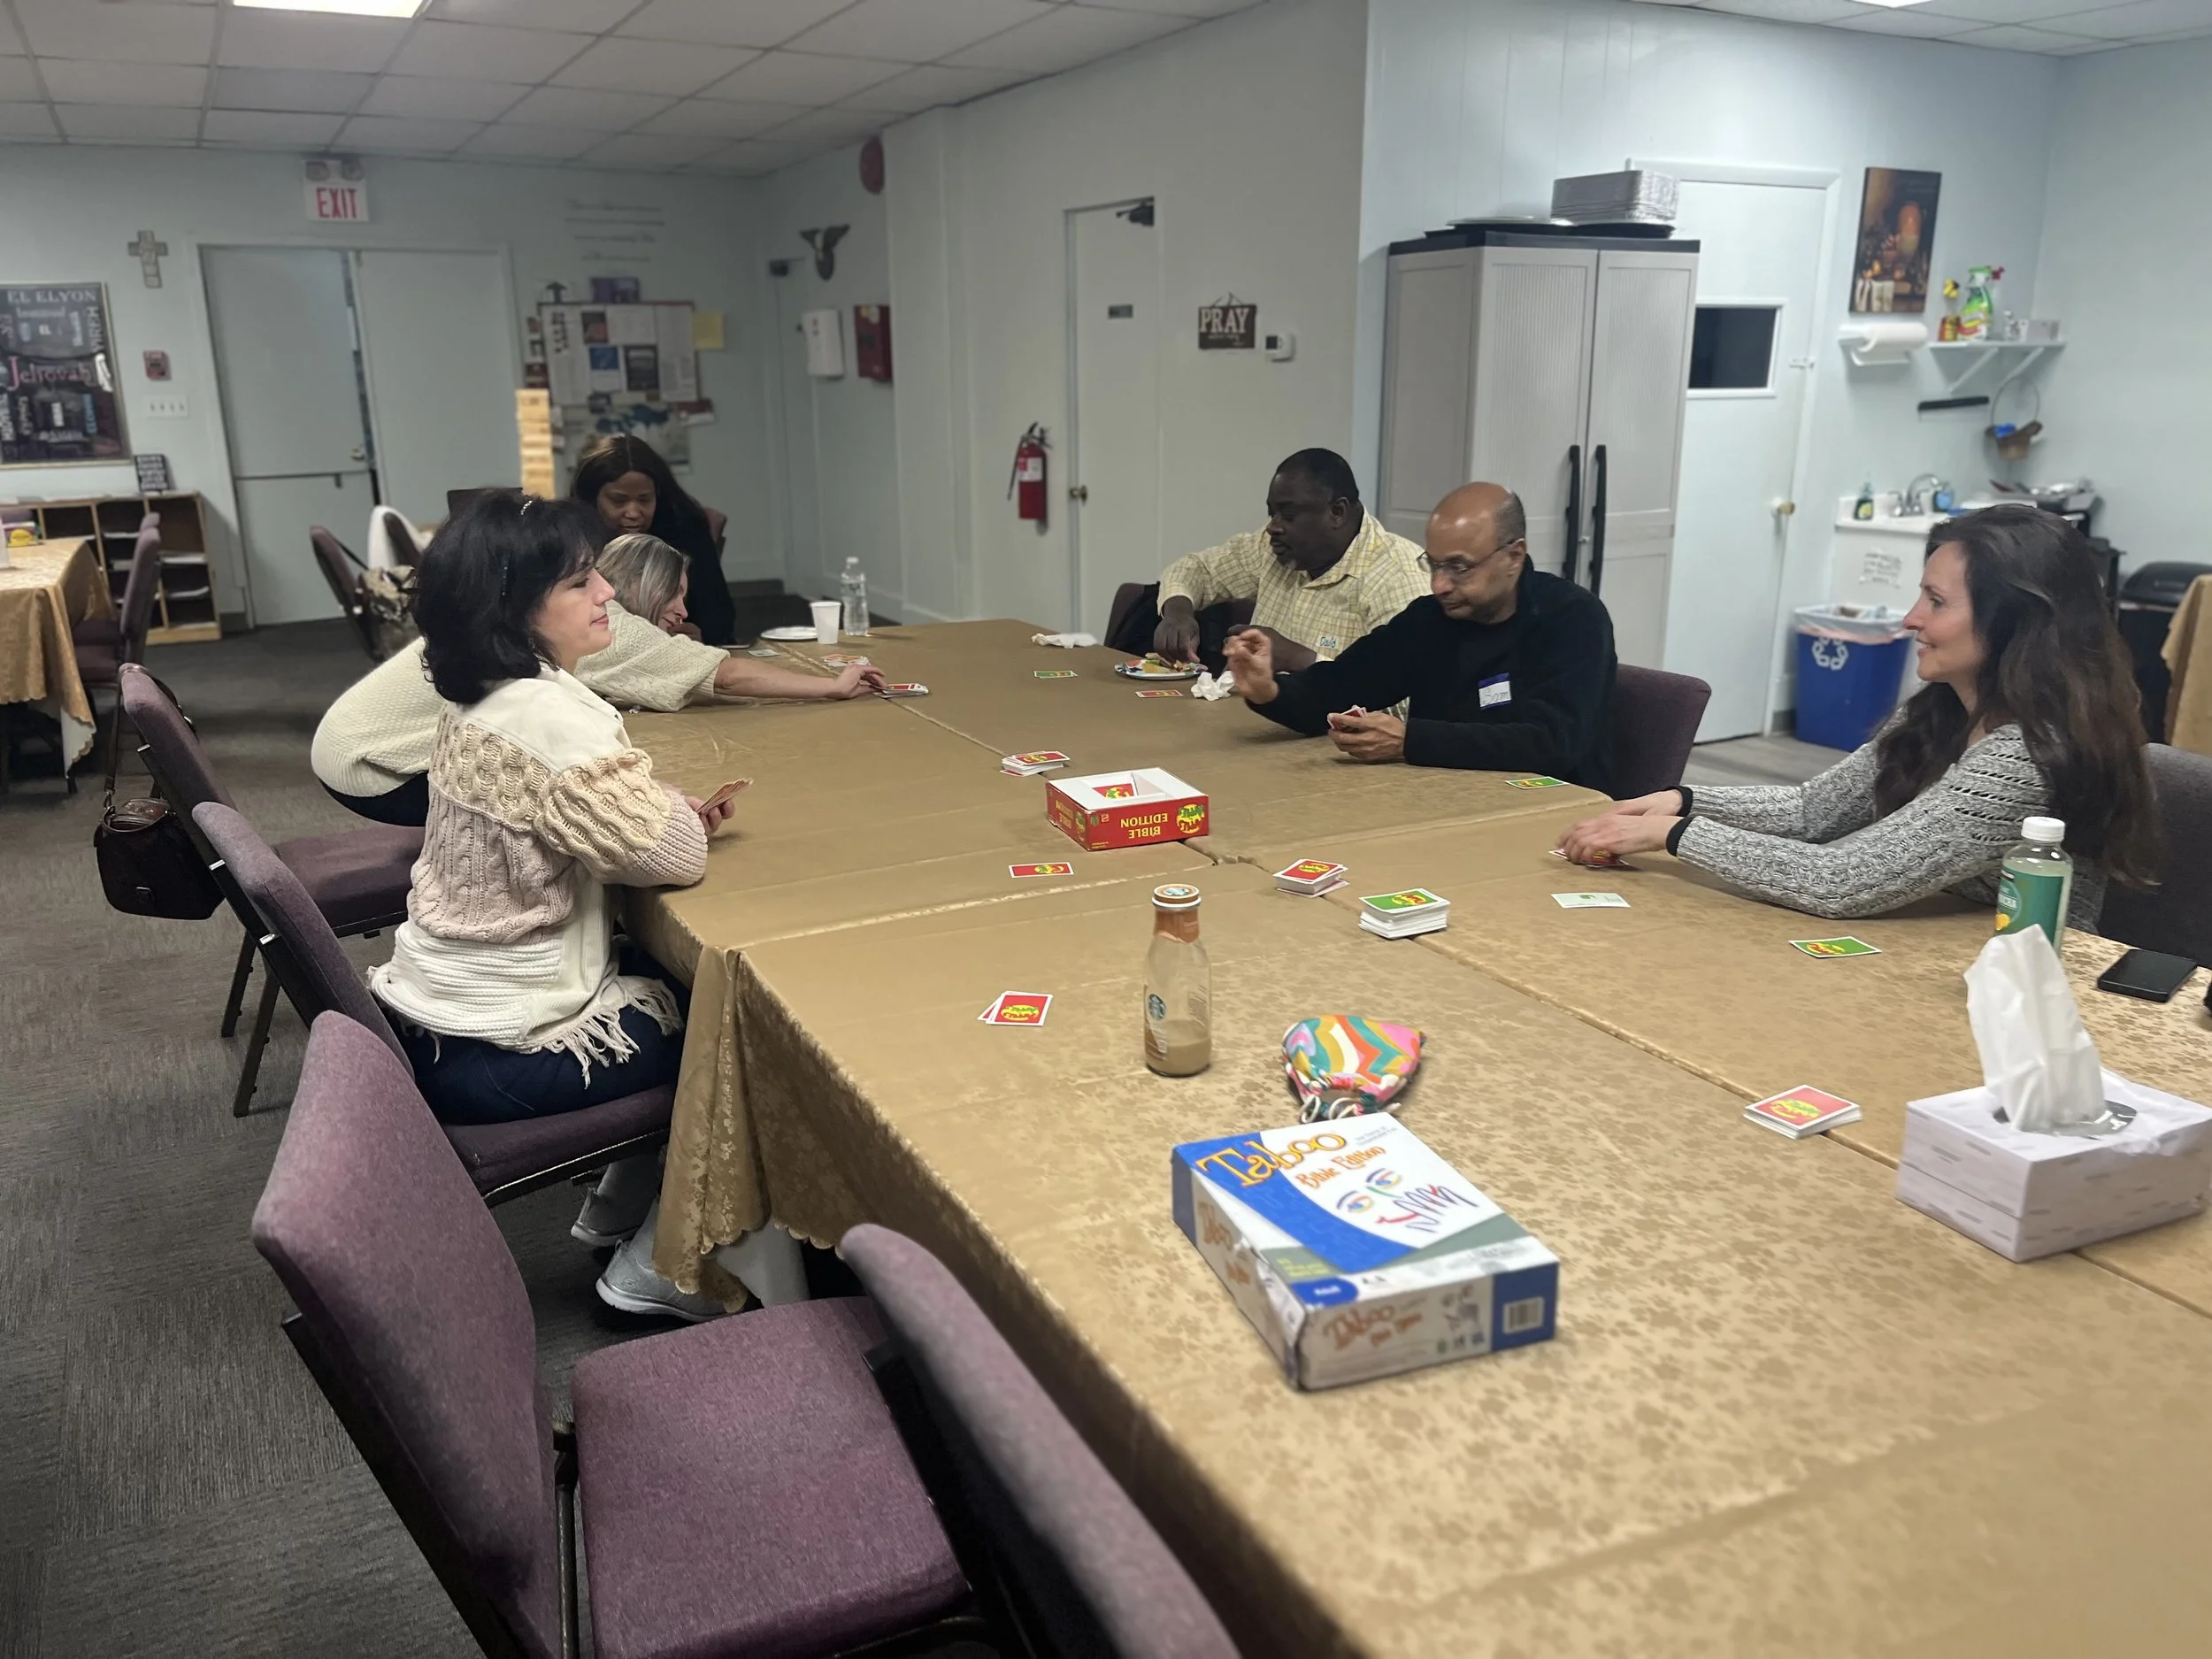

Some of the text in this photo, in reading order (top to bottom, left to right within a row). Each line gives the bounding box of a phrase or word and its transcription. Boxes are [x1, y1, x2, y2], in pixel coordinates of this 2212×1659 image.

[316, 187, 357, 219] EXIT
[7, 289, 96, 304] EL ELYON
[1200, 307, 1249, 334] PRAY
[7, 355, 92, 391] Jehovah
[1120, 812, 1169, 828] EDITION
[1128, 826, 1162, 840] BIBLE
[1194, 1132, 1347, 1187] Taboo
[1294, 1146, 1386, 1189] Bible Edition
